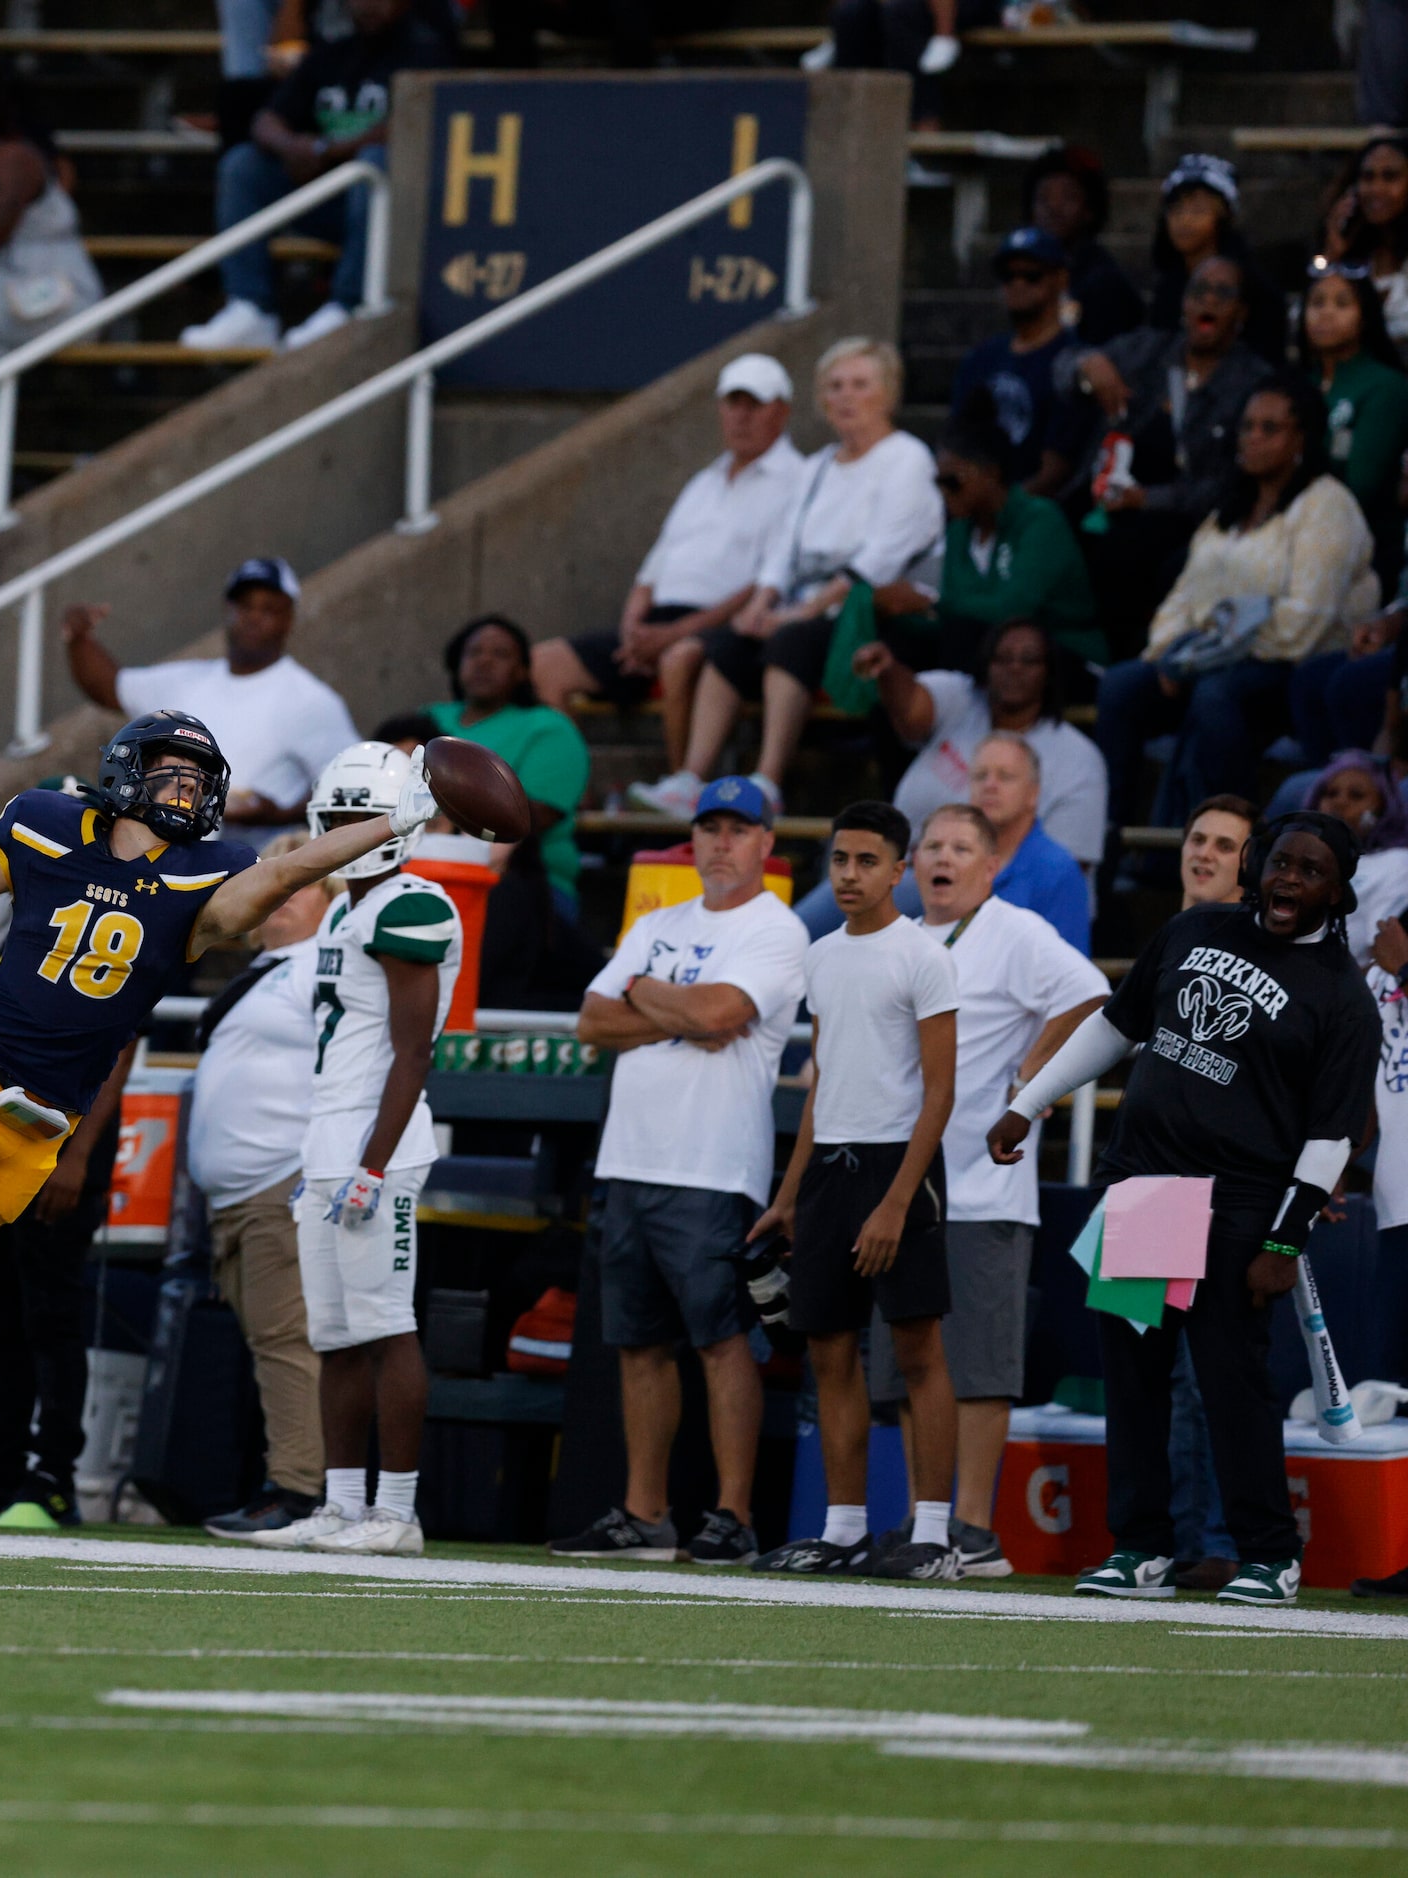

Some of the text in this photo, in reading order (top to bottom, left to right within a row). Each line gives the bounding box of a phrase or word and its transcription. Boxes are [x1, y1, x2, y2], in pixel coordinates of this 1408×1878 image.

[442, 111, 524, 227] H
[85, 883, 129, 908] SCOTS
[36, 899, 144, 1000] 18
[1177, 946, 1290, 1022] BERKNER
[1151, 1026, 1239, 1086] THE HERD
[393, 1194, 412, 1272] RAMS
[1025, 1464, 1074, 1535] G
